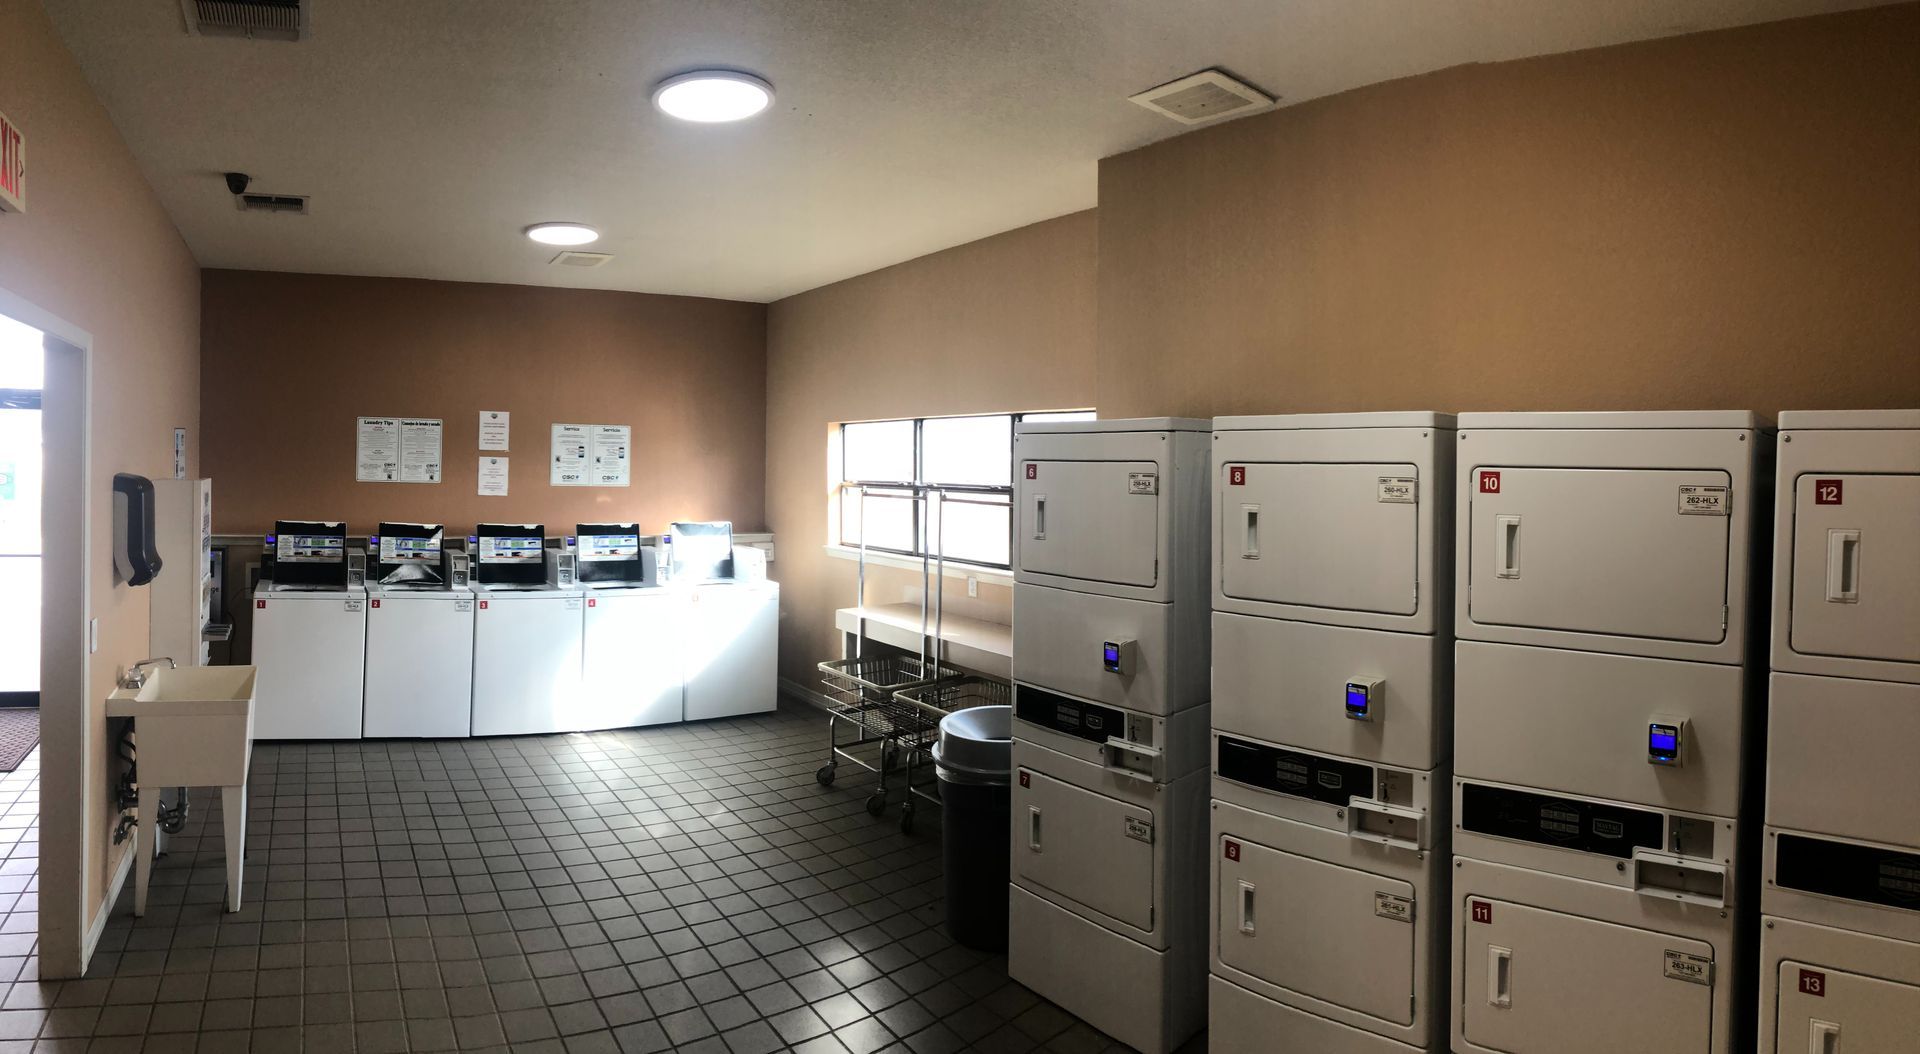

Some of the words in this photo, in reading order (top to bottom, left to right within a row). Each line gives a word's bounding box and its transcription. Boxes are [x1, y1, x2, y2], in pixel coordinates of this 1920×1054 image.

[0, 117, 21, 200] XIT
[1028, 468, 1034, 477] 6
[1234, 472, 1241, 482] 8
[1483, 477, 1498, 490] 10
[1820, 486, 1838, 501] 12
[1686, 496, 1719, 504] 262-HLX
[1022, 776, 1028, 784] 7
[1230, 846, 1236, 857] 9
[1475, 908, 1488, 920] 11
[1672, 962, 1703, 974] 263-HLX
[1803, 976, 1820, 992] 13
